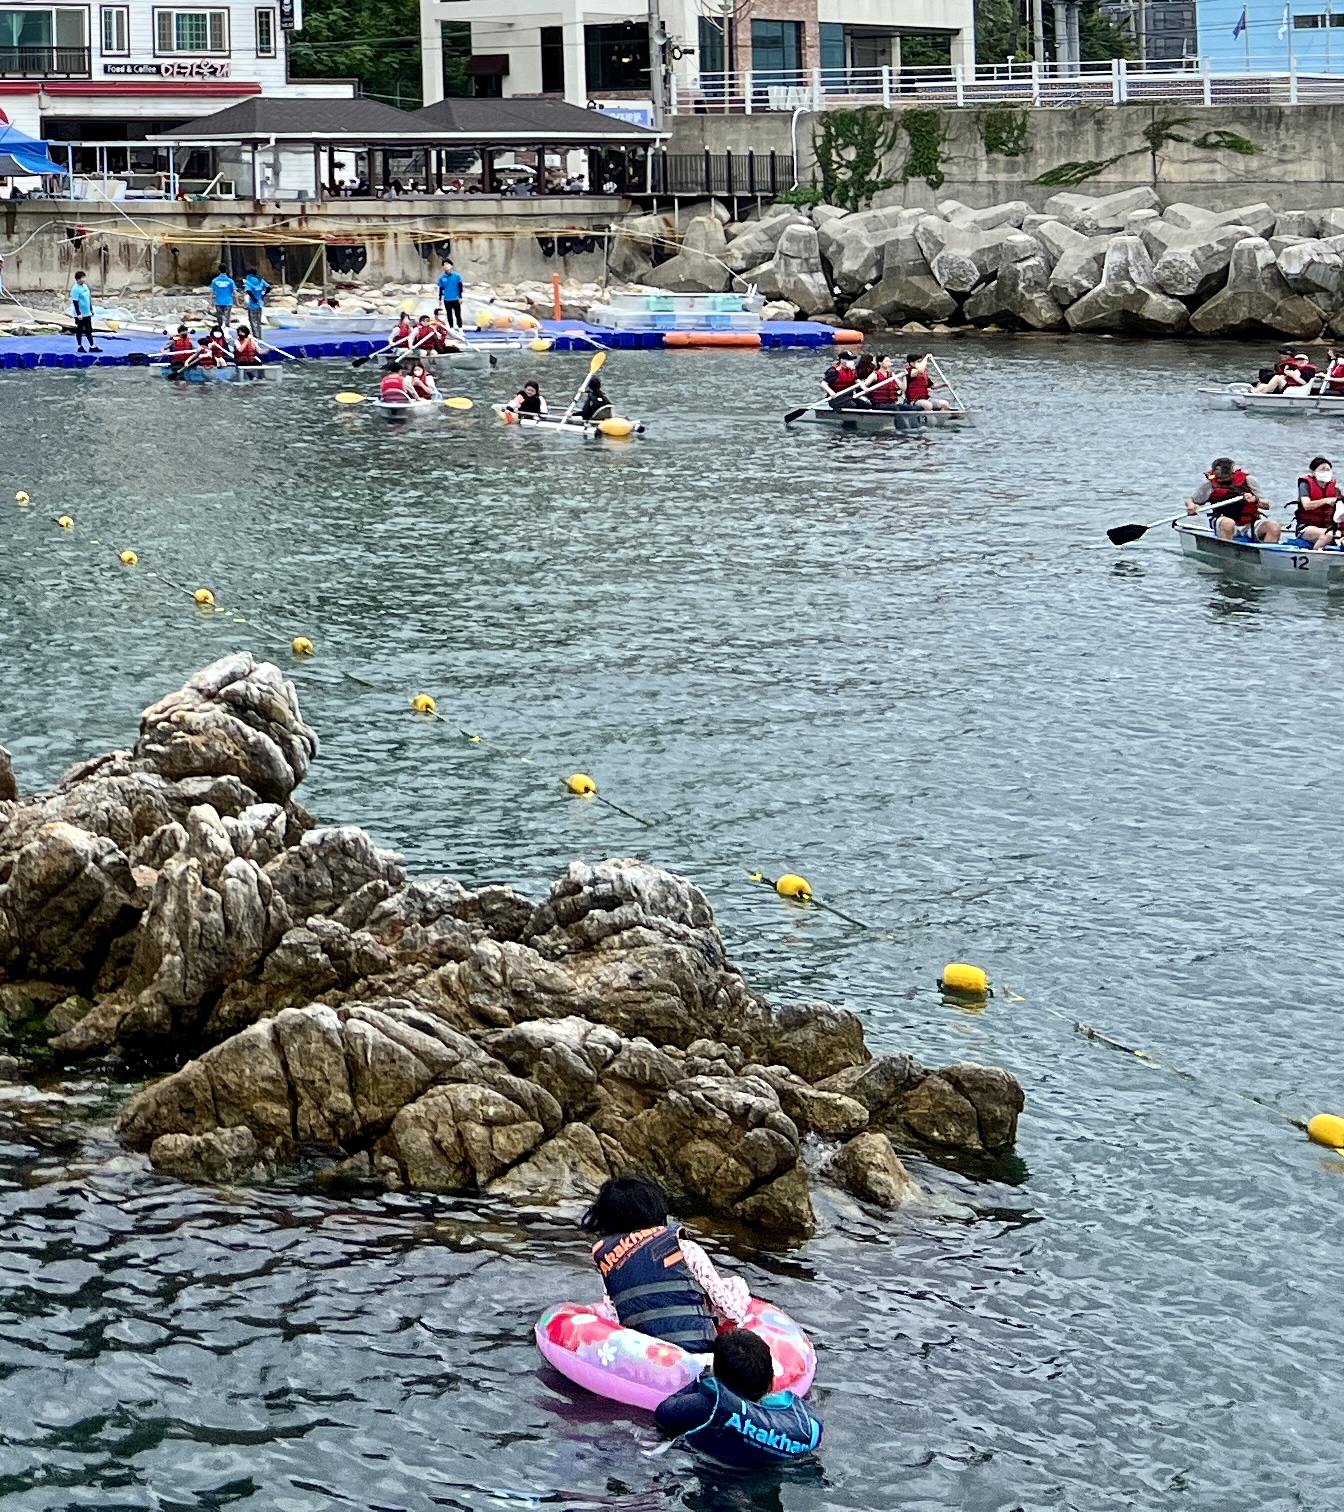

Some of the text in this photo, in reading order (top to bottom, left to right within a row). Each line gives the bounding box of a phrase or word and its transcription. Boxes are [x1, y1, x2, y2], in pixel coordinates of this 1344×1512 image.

[107, 64, 157, 74] Food & Coffee
[1290, 555, 1310, 571] 12
